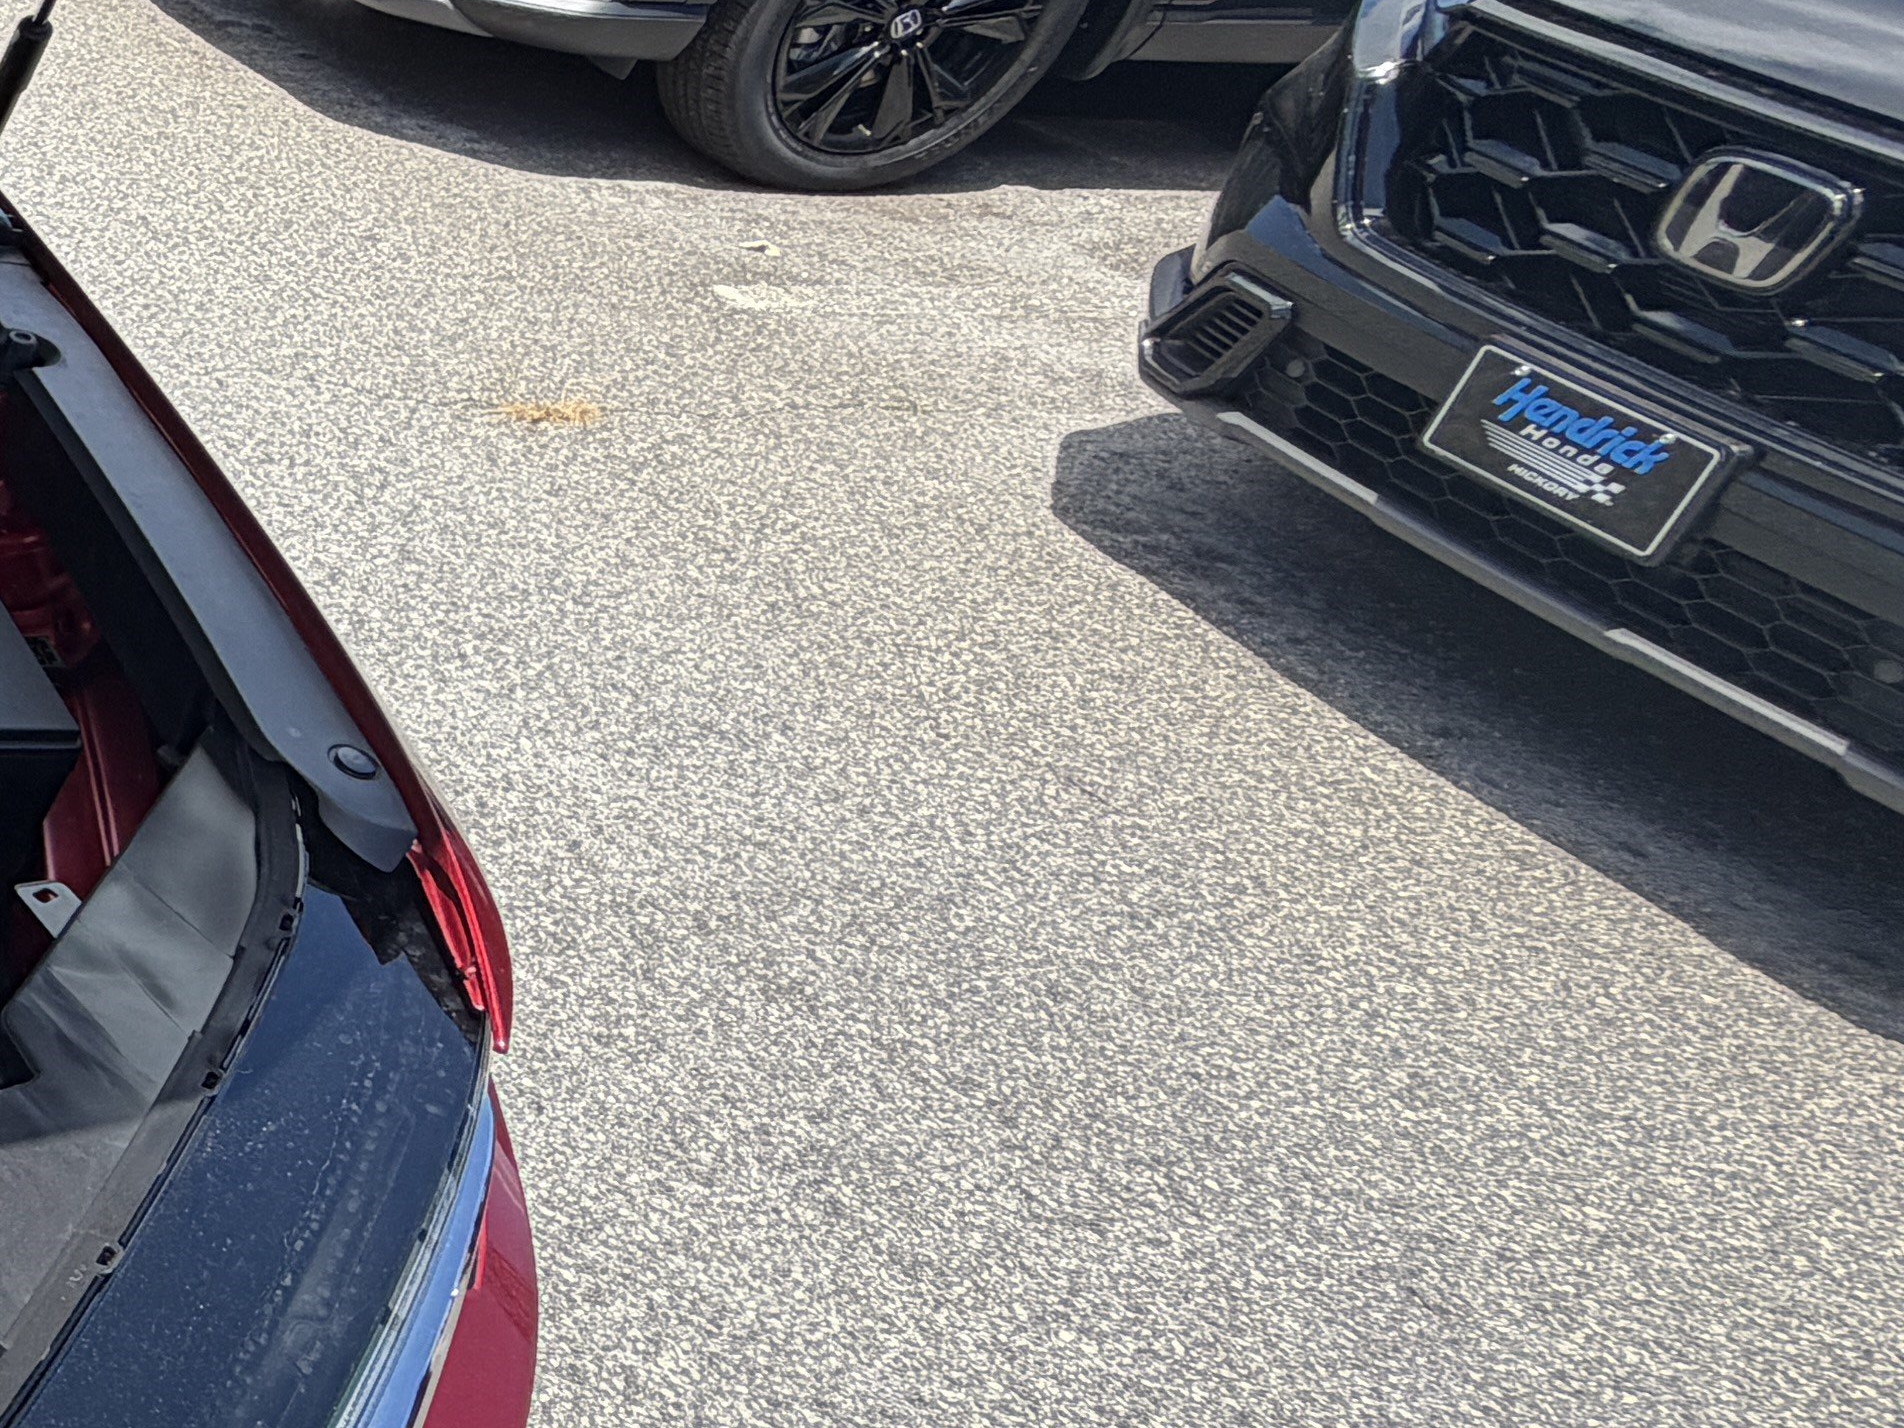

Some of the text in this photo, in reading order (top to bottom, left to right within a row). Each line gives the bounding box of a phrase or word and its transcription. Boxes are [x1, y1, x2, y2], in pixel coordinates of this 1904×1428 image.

[1492, 377, 1670, 475] Hendrick
[1519, 423, 1616, 475] Honda
[1506, 463, 1582, 501] HICKORY
